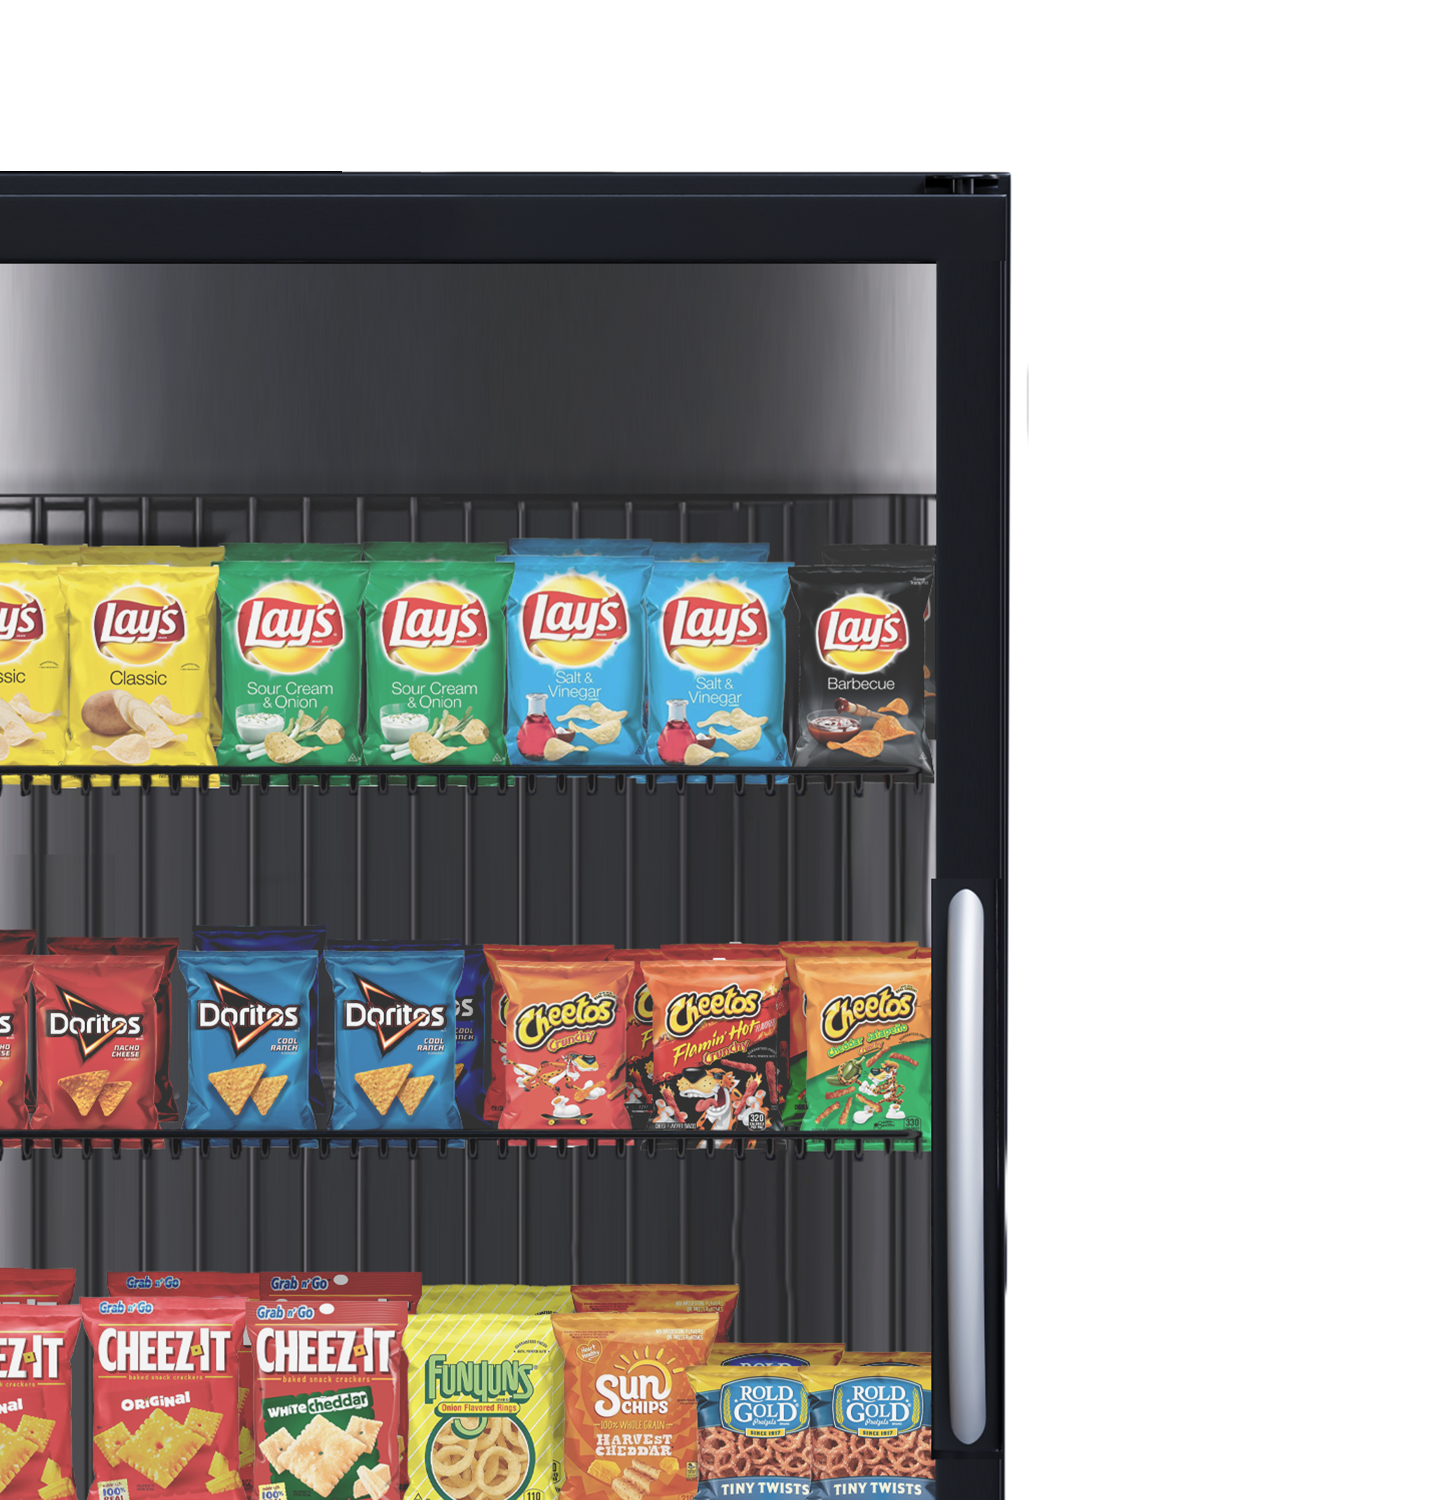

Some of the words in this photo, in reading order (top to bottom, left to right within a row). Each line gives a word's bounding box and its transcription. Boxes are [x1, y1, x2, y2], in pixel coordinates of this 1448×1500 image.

[824, 612, 899, 652] Lay's
[556, 671, 579, 684] Salt
[583, 673, 593, 684] &
[827, 677, 895, 690] Barbecue
[548, 684, 602, 701] Vinegar
[345, 1001, 445, 1028] Doritos
[820, 988, 917, 1042] Cheetos
[827, 1034, 864, 1057] Cheddar
[307, 1391, 368, 1413] cheddar
[740, 1385, 792, 1402] ROLD
[734, 1403, 798, 1422] GOLD
[833, 1481, 865, 1495] TINY
[870, 1481, 922, 1496] TWISTS
